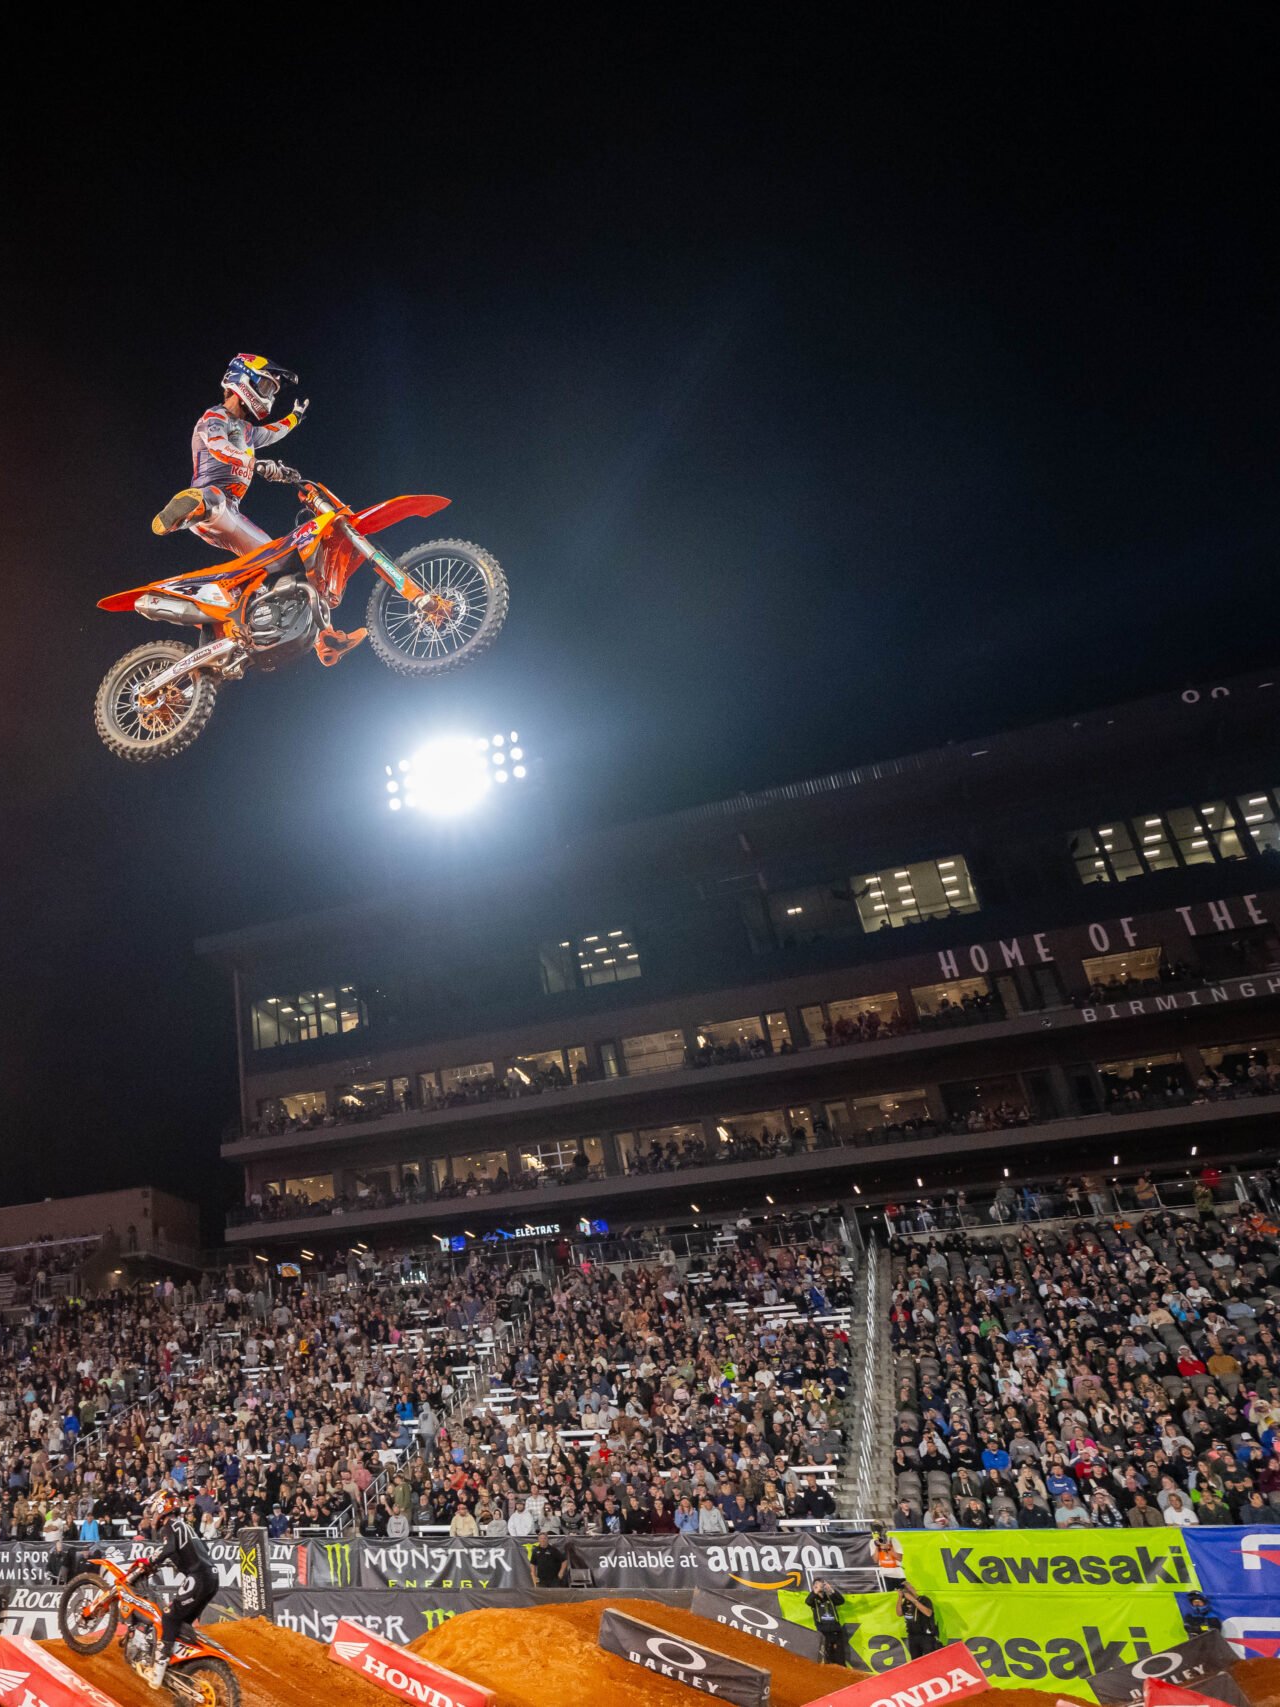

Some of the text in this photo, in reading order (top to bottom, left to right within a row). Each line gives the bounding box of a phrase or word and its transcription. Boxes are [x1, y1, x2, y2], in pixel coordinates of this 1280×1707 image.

[937, 893, 1269, 980] HOME OF THE
[15, 1551, 50, 1563] SPOR
[364, 1543, 512, 1574] MONSTER
[599, 1544, 845, 1573] available at amazon
[940, 1546, 1192, 1586] Kawasaki
[717, 1613, 790, 1648] OAKLEY
[361, 1653, 466, 1707] HOND
[628, 1650, 721, 1696] OAKLEY
